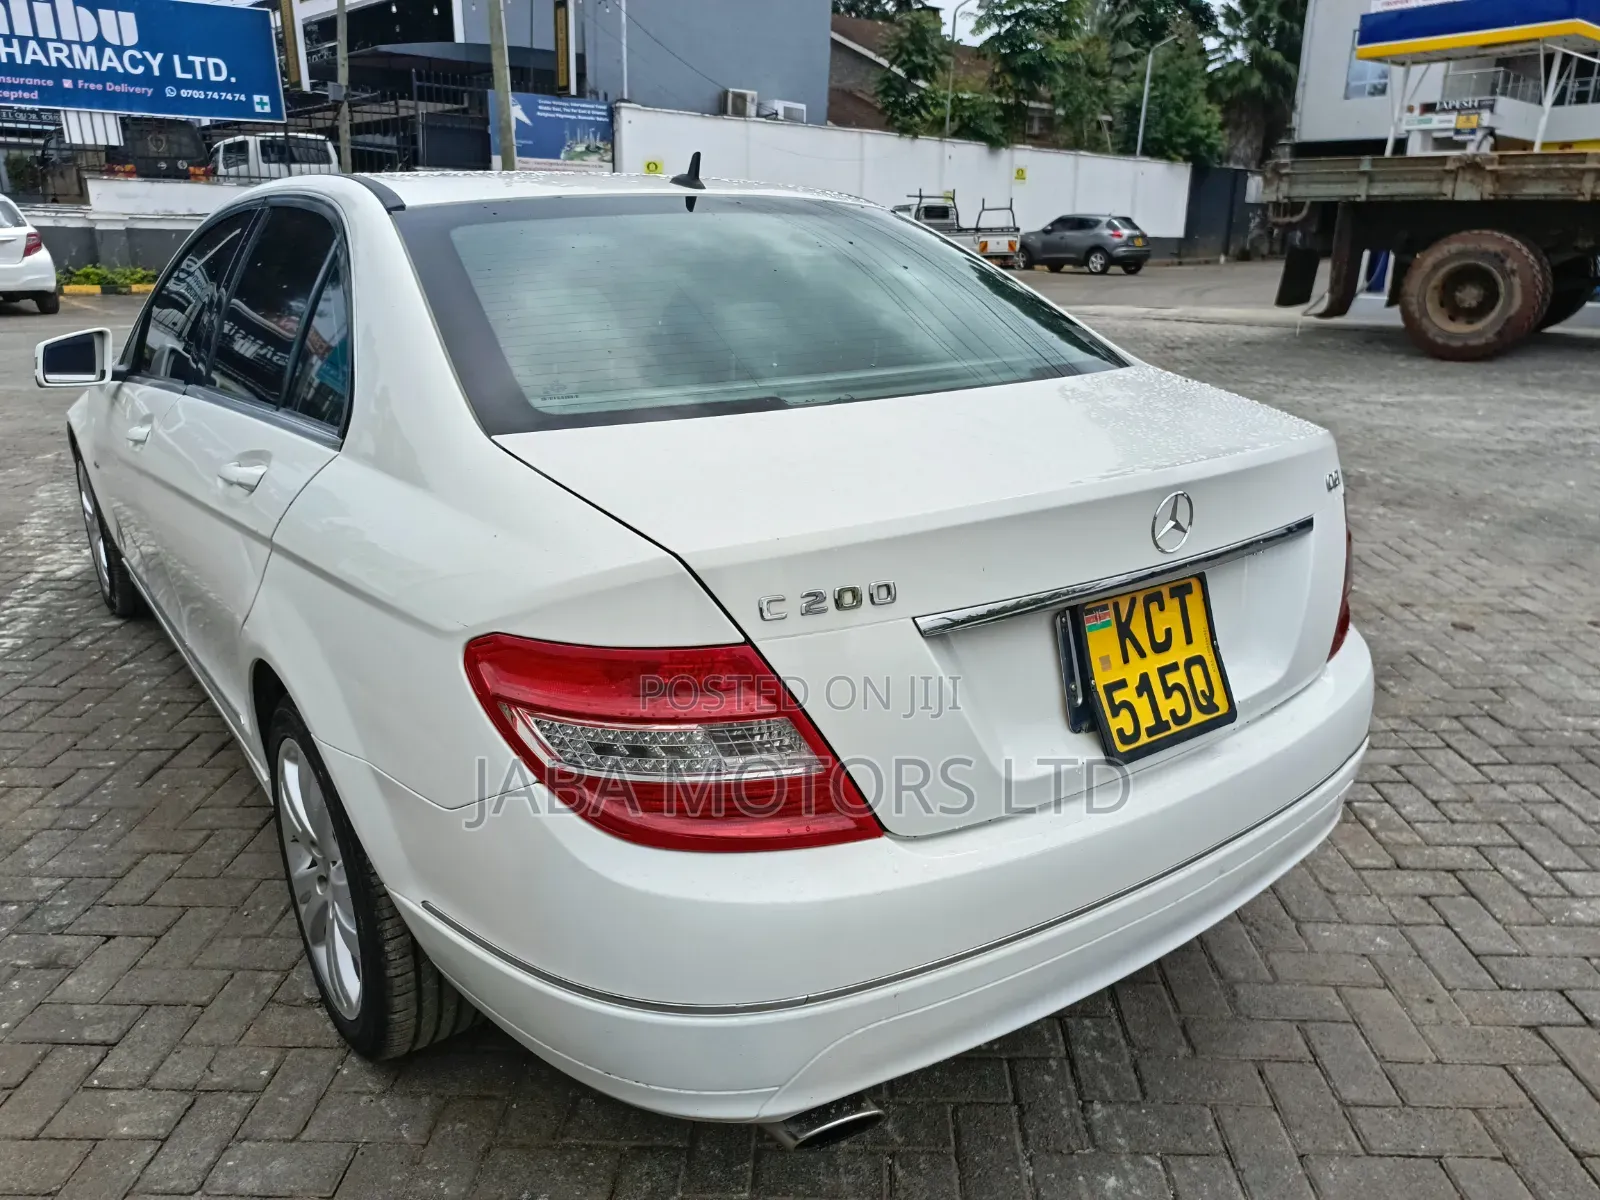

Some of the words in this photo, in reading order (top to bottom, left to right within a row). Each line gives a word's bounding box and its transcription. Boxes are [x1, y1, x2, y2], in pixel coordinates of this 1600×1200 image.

[0, 0, 139, 47] libu
[78, 79, 103, 91] Free
[106, 82, 154, 97] Delivery
[173, 54, 237, 83] LTD.
[758, 594, 788, 621] C
[800, 579, 897, 616] 200
[1113, 582, 1193, 665] KCT
[1103, 654, 1220, 746] 515Q
